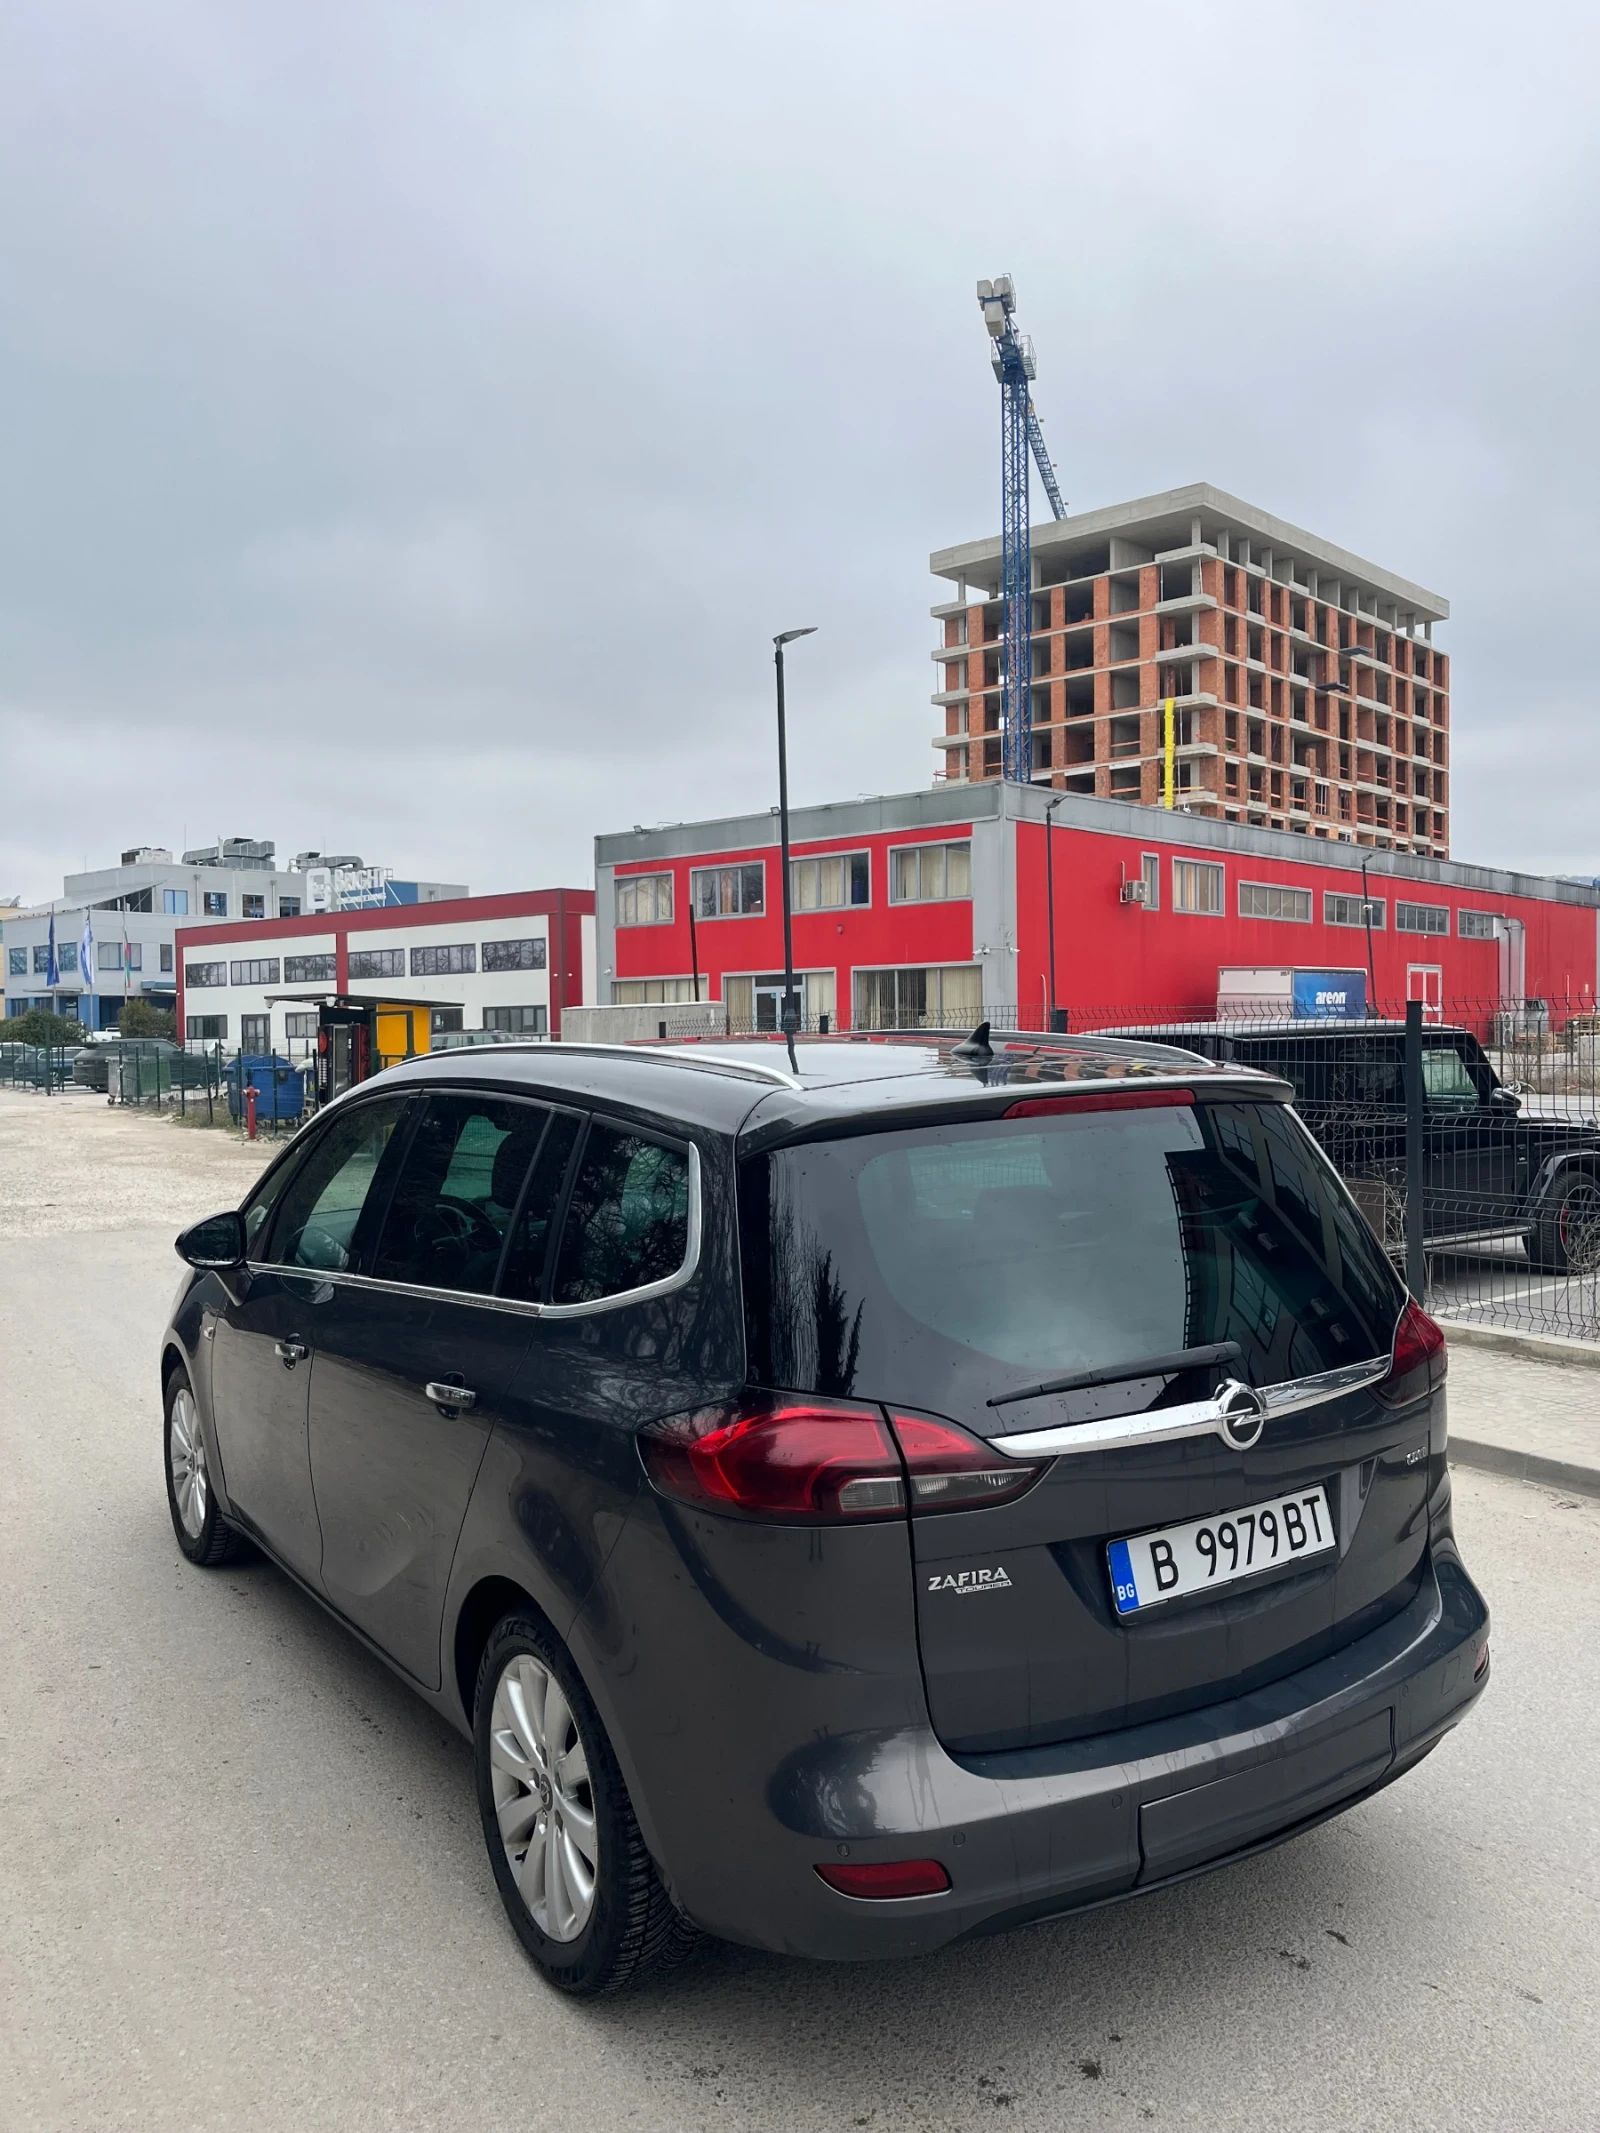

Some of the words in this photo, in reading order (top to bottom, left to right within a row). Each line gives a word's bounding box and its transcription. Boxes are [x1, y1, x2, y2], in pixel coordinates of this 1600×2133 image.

[1316, 992, 1346, 1004] areon
[1149, 1539, 1179, 1591] B
[928, 1567, 1009, 1591] ZAFIRA
[1117, 1583, 1135, 1601] BG
